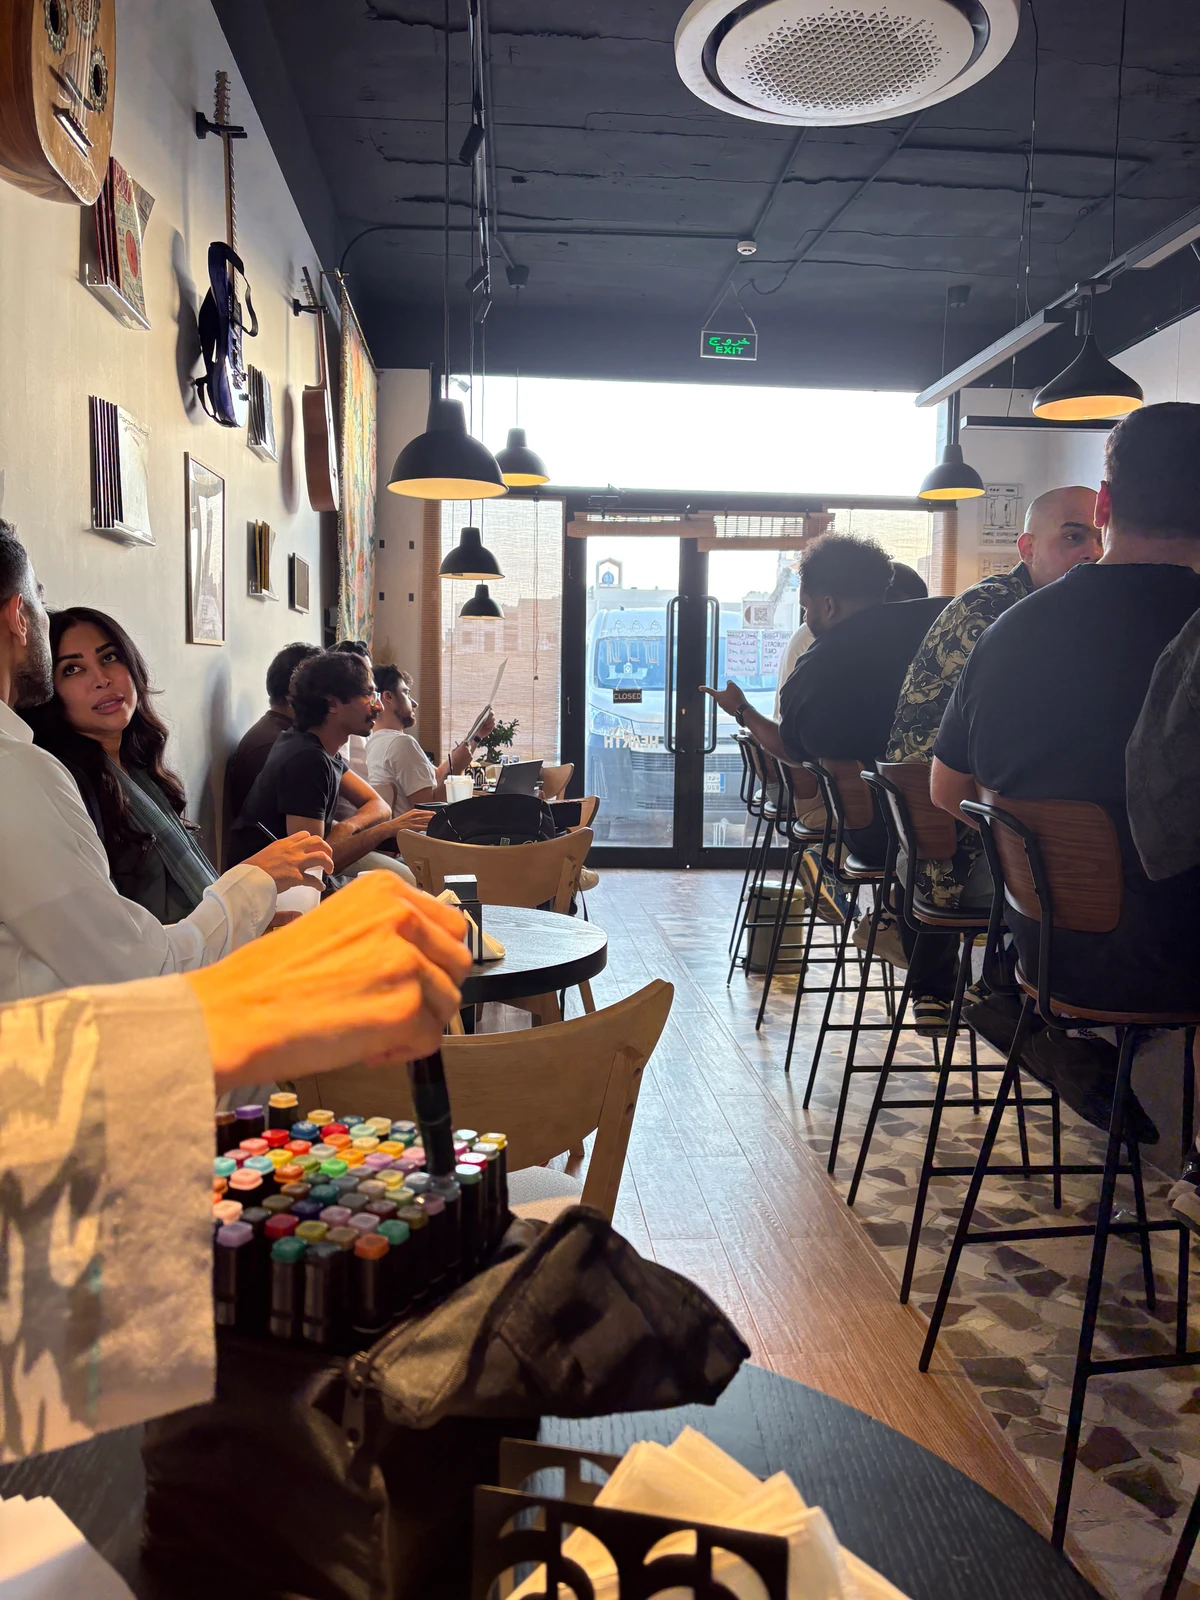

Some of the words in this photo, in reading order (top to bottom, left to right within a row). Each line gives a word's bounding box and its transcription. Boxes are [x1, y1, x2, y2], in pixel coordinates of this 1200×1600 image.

[708, 336, 750, 347] خروج
[715, 346, 743, 354] EXIT
[613, 692, 642, 700] CLOSED
